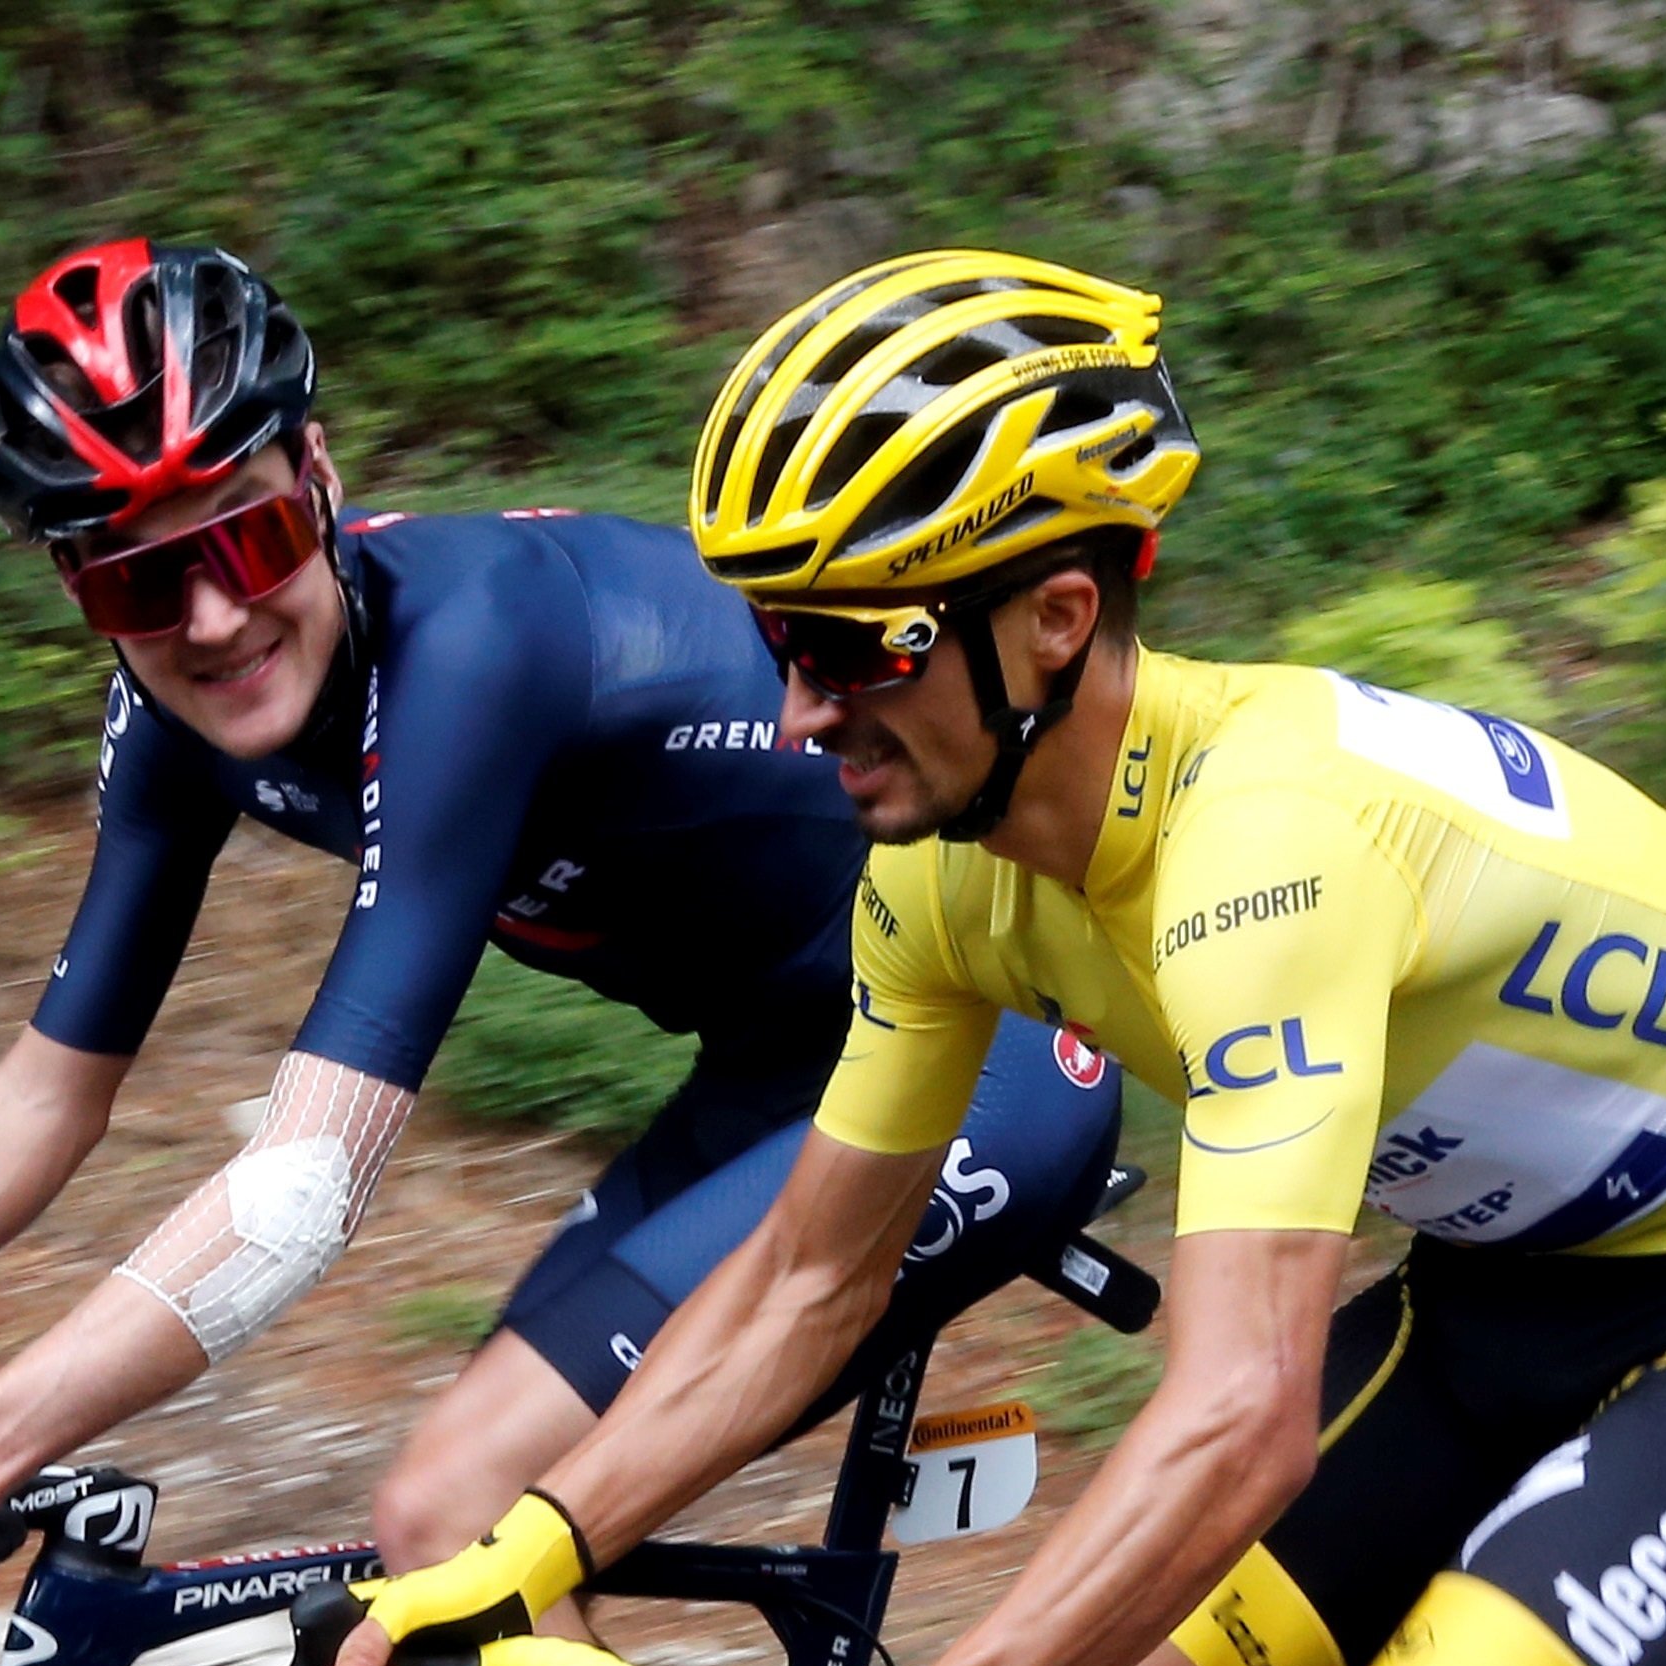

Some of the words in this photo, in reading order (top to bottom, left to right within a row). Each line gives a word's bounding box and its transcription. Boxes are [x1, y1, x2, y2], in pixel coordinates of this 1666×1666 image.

[884, 470, 1034, 582] SPECIALIZED
[1117, 735, 1151, 819] LCL
[1165, 911, 1207, 958] COQ
[1214, 875, 1323, 933] SPORTIF
[870, 1350, 918, 1456] INEOS
[913, 1410, 1010, 1447] Continental
[947, 1457, 977, 1530] 7
